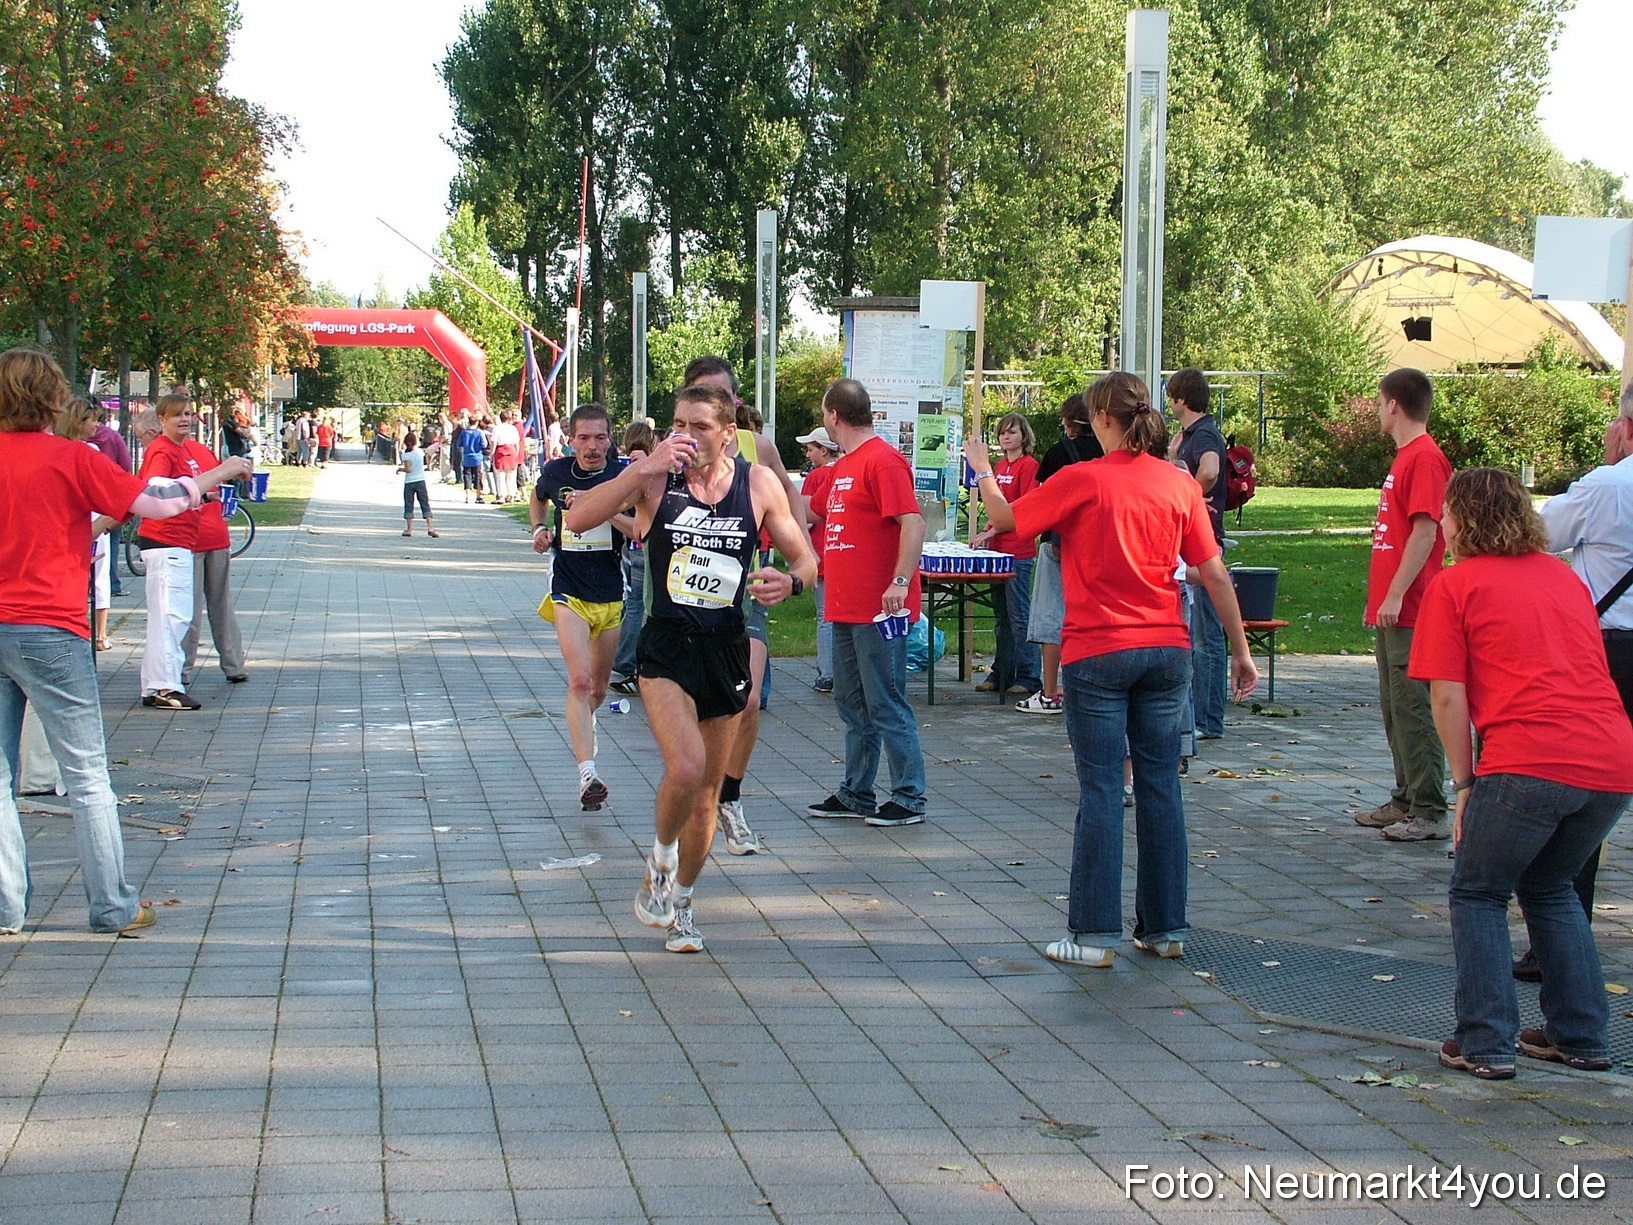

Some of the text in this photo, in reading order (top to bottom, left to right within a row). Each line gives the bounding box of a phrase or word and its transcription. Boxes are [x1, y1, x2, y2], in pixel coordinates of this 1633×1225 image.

[304, 321, 416, 335] pflegung LGS-Park
[685, 517, 740, 531] NAGEL
[672, 532, 742, 550] SC Roth 52
[689, 554, 711, 568] Ralf
[672, 565, 681, 575] A
[685, 574, 722, 594] 402
